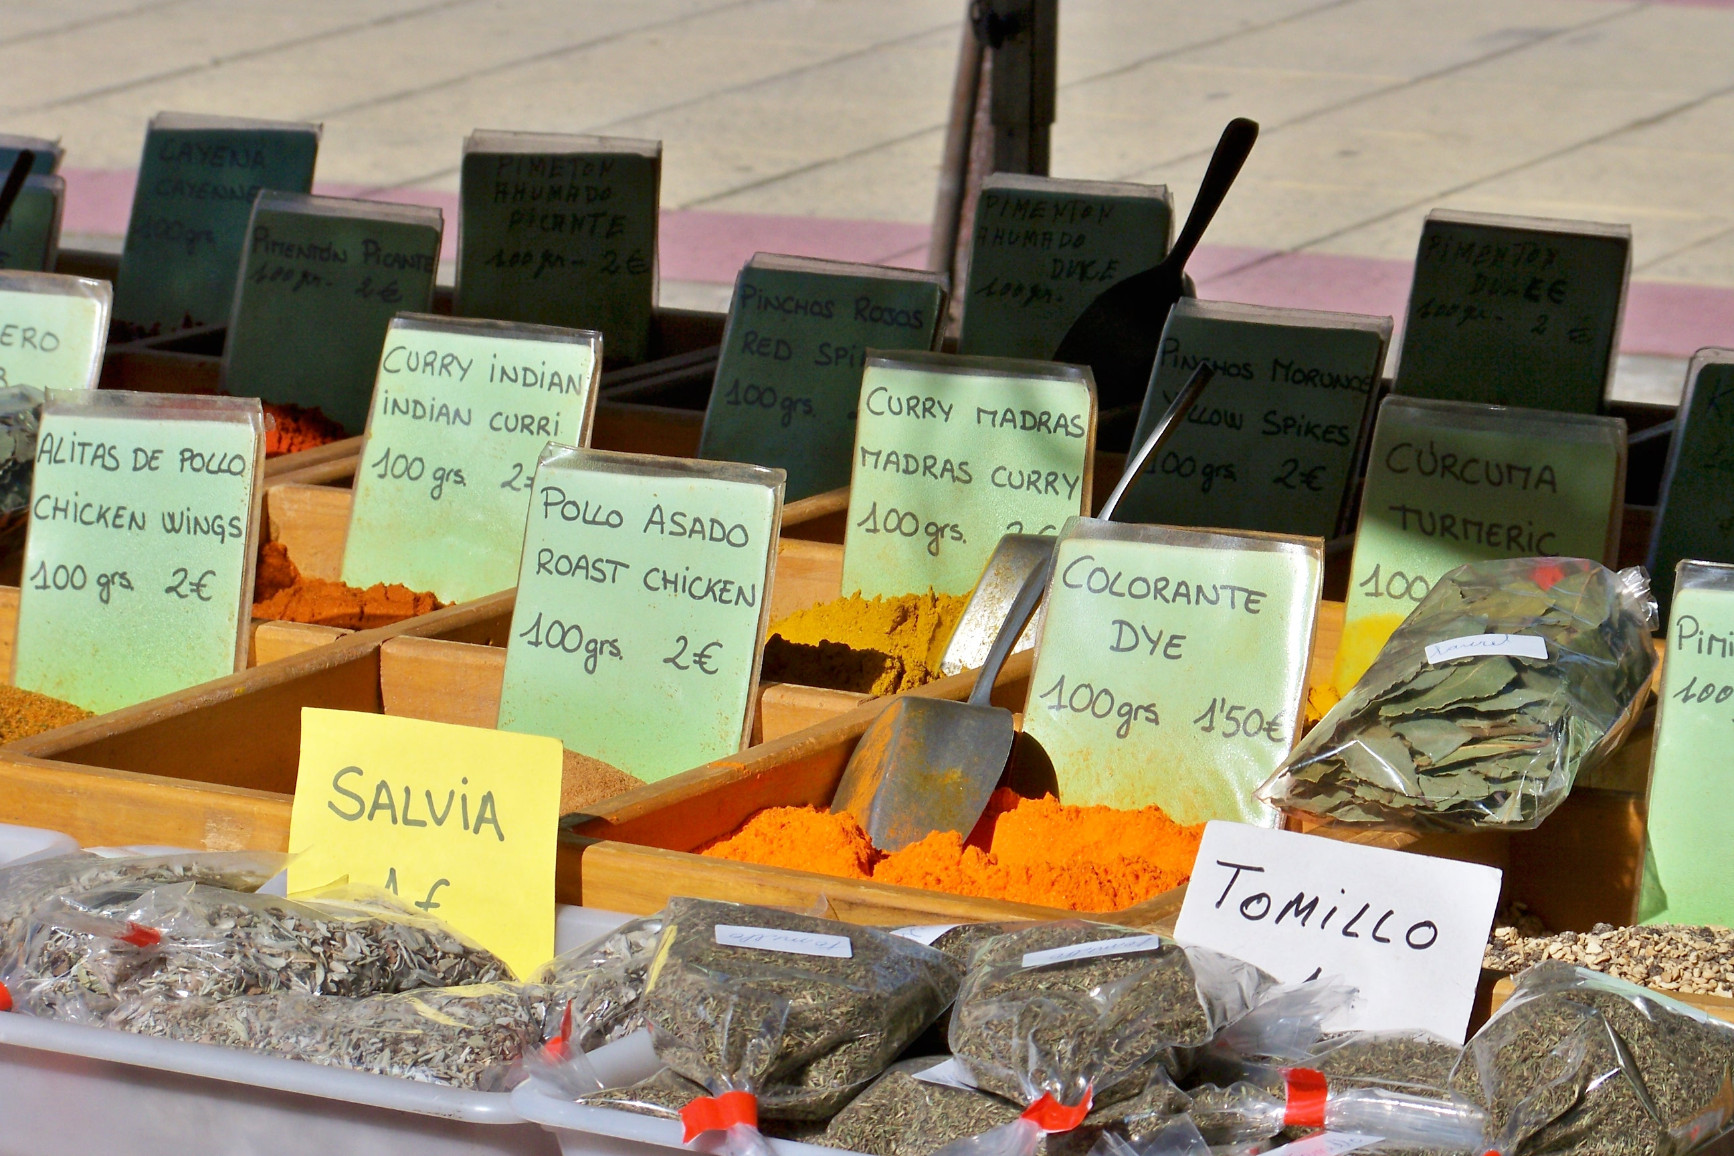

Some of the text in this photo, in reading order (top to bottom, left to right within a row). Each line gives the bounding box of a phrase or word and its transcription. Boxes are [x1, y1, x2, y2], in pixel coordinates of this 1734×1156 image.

[0, 324, 60, 352] ERO
[742, 330, 866, 367] RED SPI
[382, 345, 473, 382] CURRY
[865, 386, 1087, 439] CURRY MADRAS
[132, 448, 165, 471] DE
[179, 448, 246, 476] POLLO
[859, 446, 1081, 500] MADRAS CURRY
[540, 486, 624, 529] POLLO
[164, 567, 218, 602] 2€
[536, 548, 630, 585] ROAST
[1061, 555, 1268, 615] COLORANTE
[1359, 563, 1430, 602] 100
[662, 635, 724, 676] 2€
[1109, 619, 1187, 660] DYE
